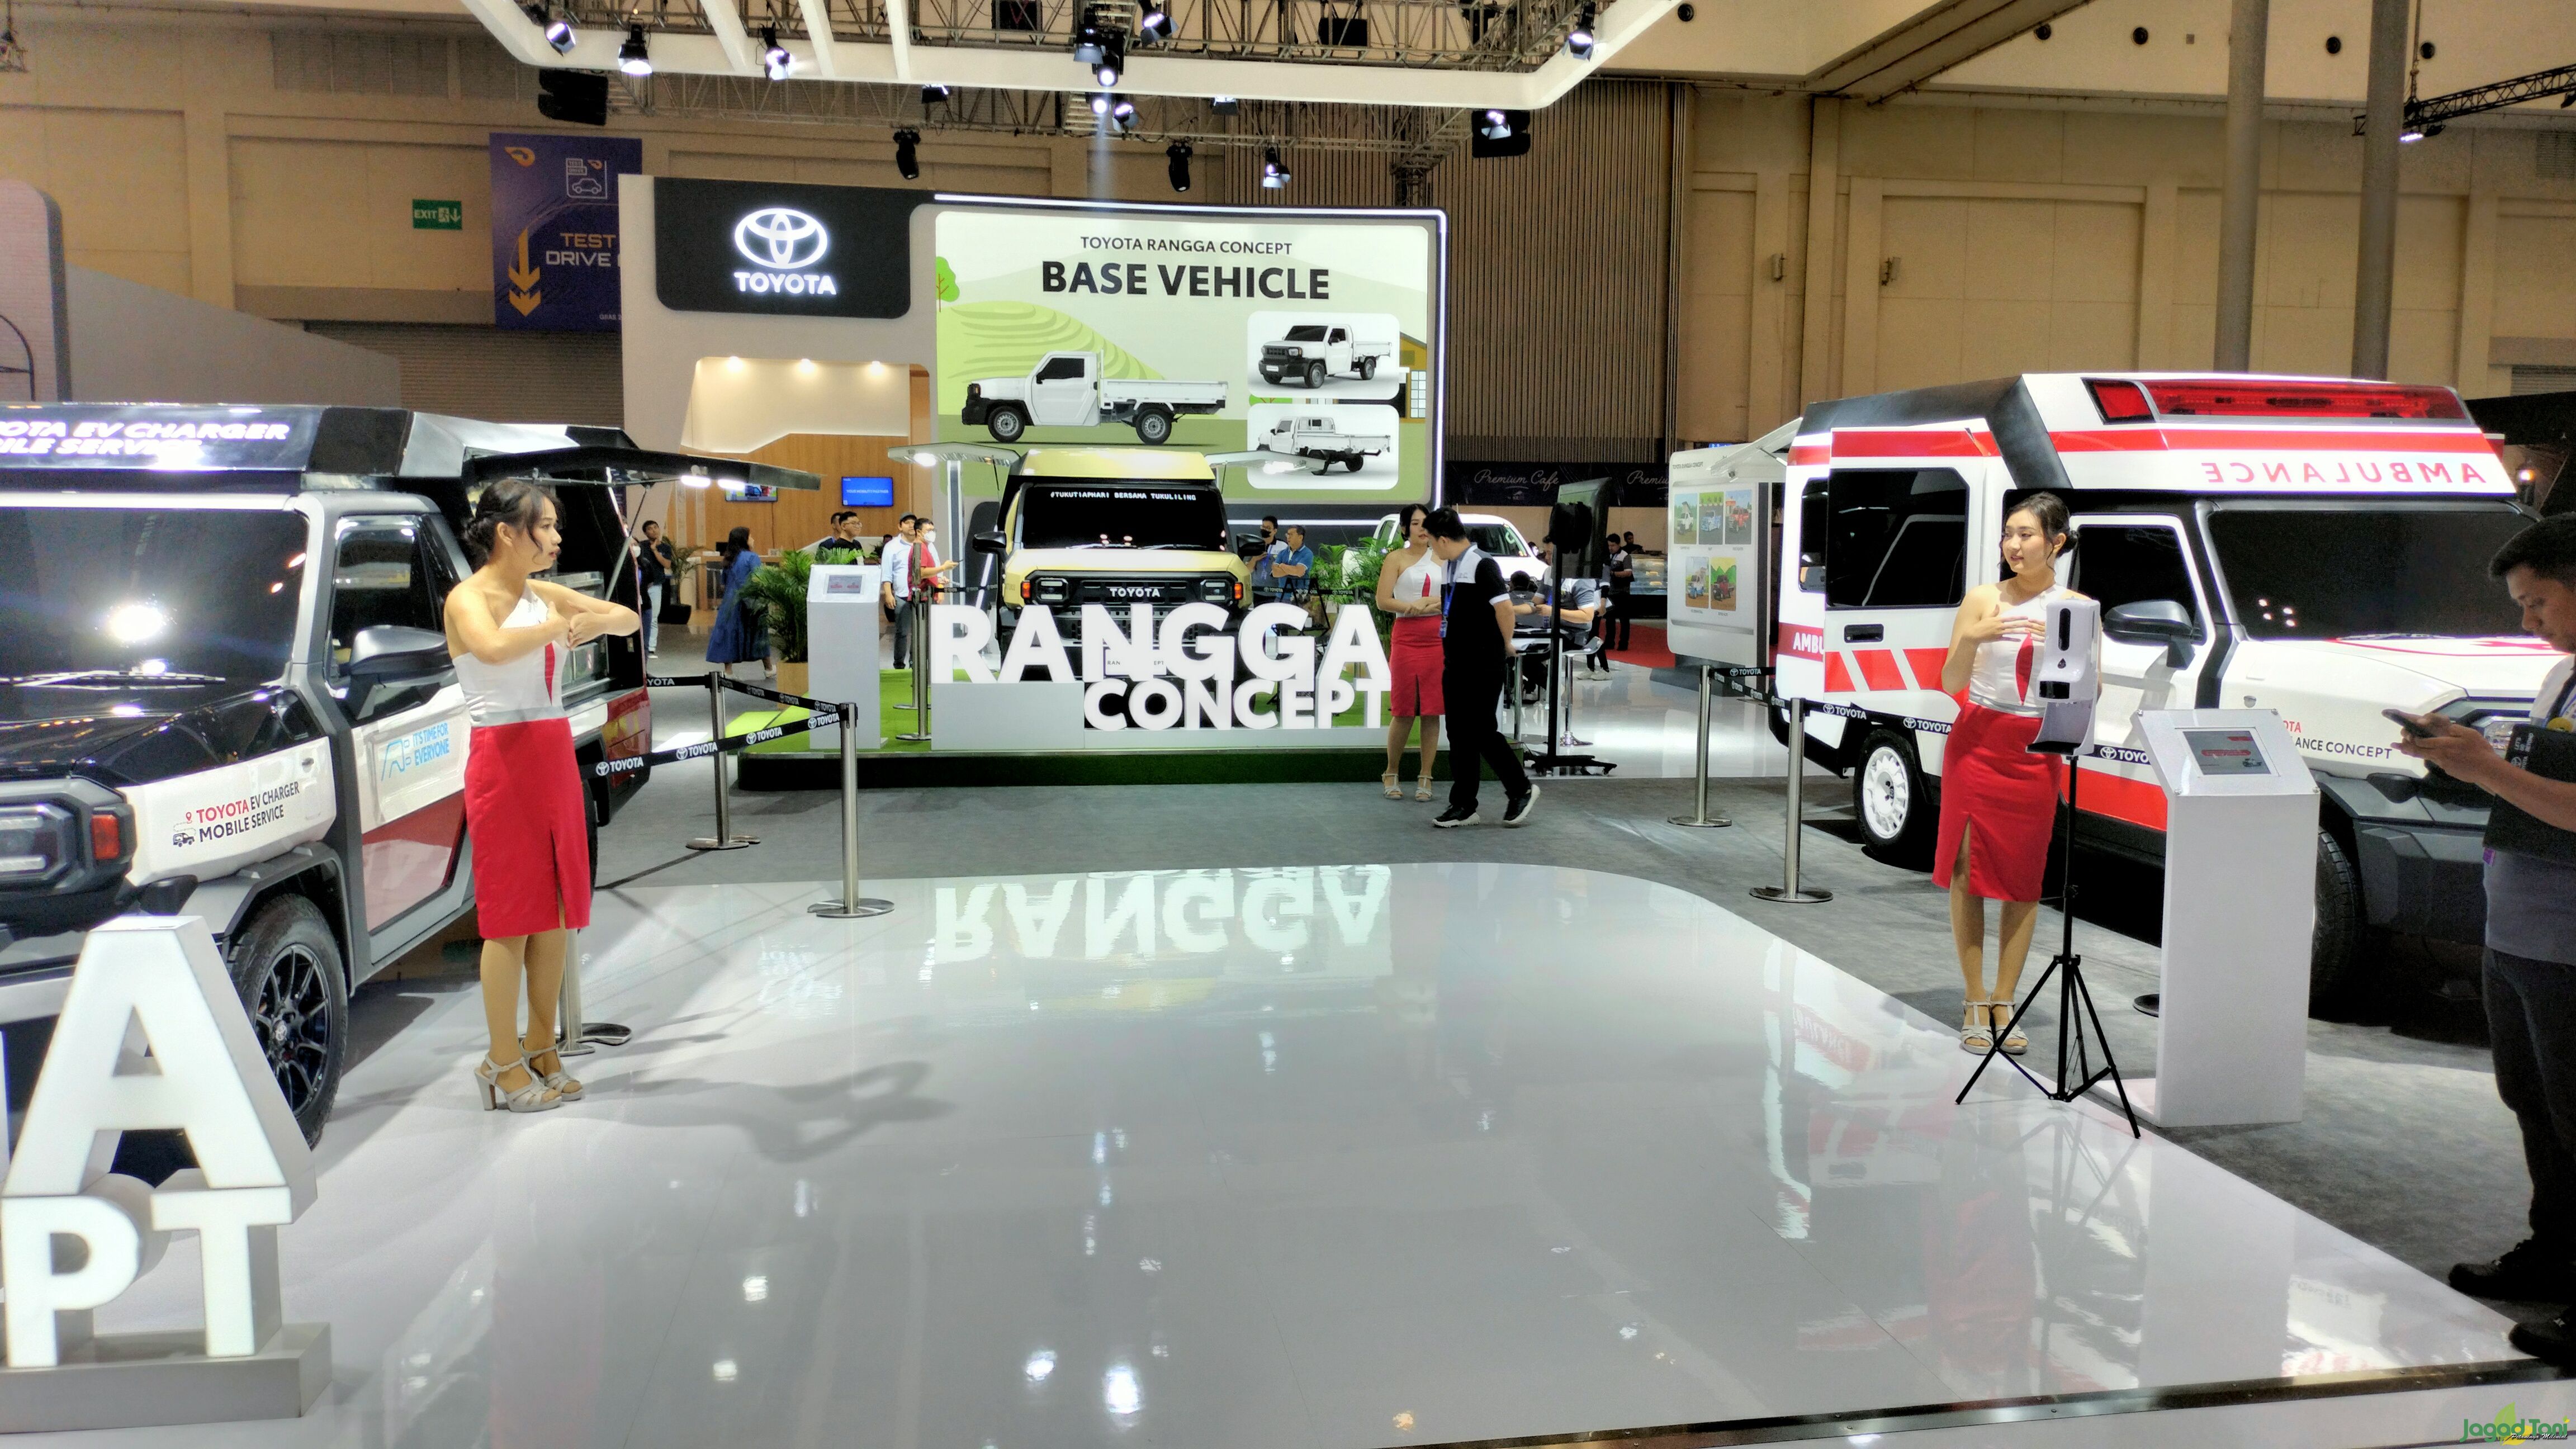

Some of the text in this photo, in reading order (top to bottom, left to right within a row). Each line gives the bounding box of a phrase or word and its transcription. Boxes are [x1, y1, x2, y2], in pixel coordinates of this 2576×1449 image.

[414, 209, 437, 219] EXIT
[560, 233, 617, 248] TEST
[1080, 236, 1292, 255] TOYOTA RANGGA CONCEPT
[546, 250, 612, 267] DRIVE
[733, 272, 837, 296] TOYOTA
[1041, 261, 1330, 300] BASE VEHICLE
[73, 422, 125, 438] EV
[124, 423, 290, 440] CHARGER
[1474, 469, 1559, 491] Premium Cafe
[1627, 470, 1669, 484] Premiu
[1150, 493, 1196, 501] TUKULILING
[1110, 588, 1161, 598] TOYOTA
[931, 603, 1391, 683] RANGGA
[646, 677, 675, 686] YOTA
[820, 703, 837, 712] TOYOTA
[1083, 678, 1391, 731] CONCEPT
[1835, 706, 1867, 720] TOYOTA
[817, 712, 840, 726] TOYOTA
[1917, 720, 1952, 733] TOYOTA
[424, 727, 437, 742] TIME
[437, 722, 449, 737] FOR
[756, 727, 783, 742] TOYOTA
[414, 738, 449, 766] EVERYONE
[688, 741, 718, 757] TOYOTA
[2118, 750, 2149, 763] TOYO
[2326, 741, 2393, 760] CONCEPT
[609, 756, 644, 773] TOYOTA
[196, 781, 300, 823] TOYOTA EV CHARGER
[199, 804, 285, 842] MOBILE SERVICE
